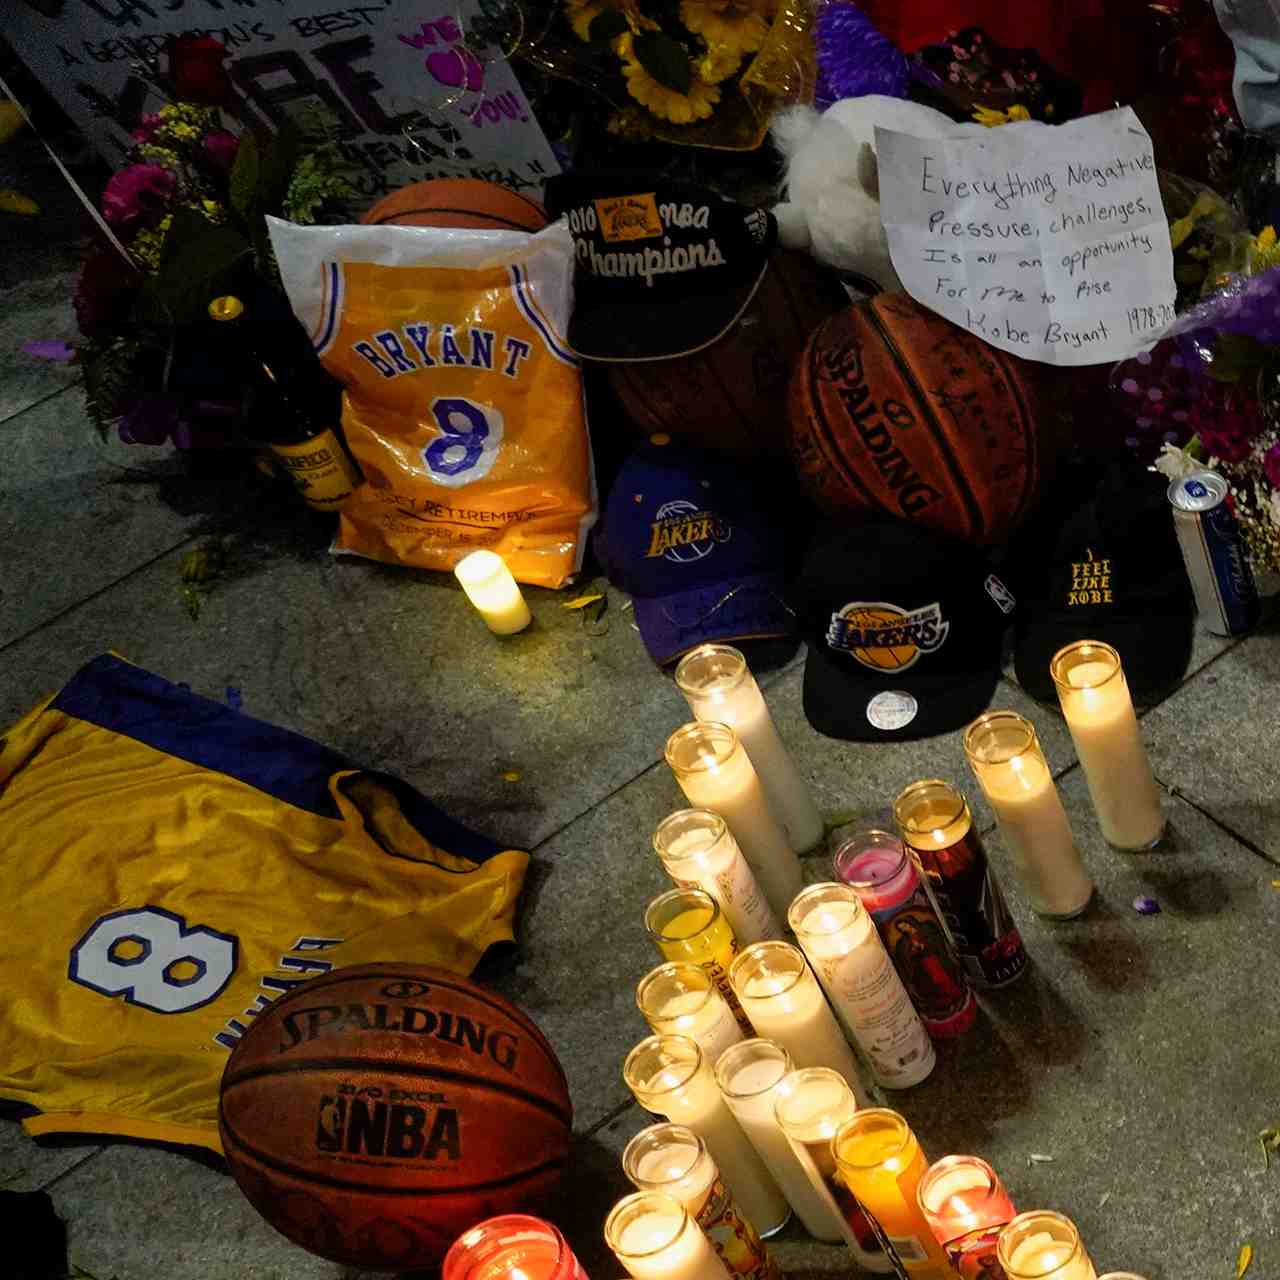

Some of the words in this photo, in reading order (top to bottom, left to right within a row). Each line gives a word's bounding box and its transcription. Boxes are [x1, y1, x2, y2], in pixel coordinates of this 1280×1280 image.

[288, 7, 384, 38] BEST
[921, 155, 1057, 210] Everything
[1066, 153, 1155, 188] Negative
[927, 209, 1041, 238] Pressure,
[1049, 197, 1152, 234] challenges,
[575, 236, 728, 288] Champions
[923, 248, 962, 265] Is
[976, 252, 997, 265] all
[1018, 258, 1043, 270] an
[1060, 232, 1154, 277] opportunity
[934, 276, 967, 298] For
[1040, 292, 1058, 304] to
[965, 309, 1031, 345] Kobe
[1043, 319, 1111, 349] Bryant
[355, 325, 532, 379] BRYANT
[424, 399, 490, 475] 8
[818, 342, 945, 520] SPALDING
[1070, 559, 1112, 579] FEEL
[1071, 576, 1111, 592] LIKE
[1067, 589, 1114, 607] KOBE
[834, 614, 949, 652] LAKERS
[68, 903, 239, 1015] 8
[278, 1003, 520, 1072] SPALDING
[347, 1099, 462, 1160] NBA
